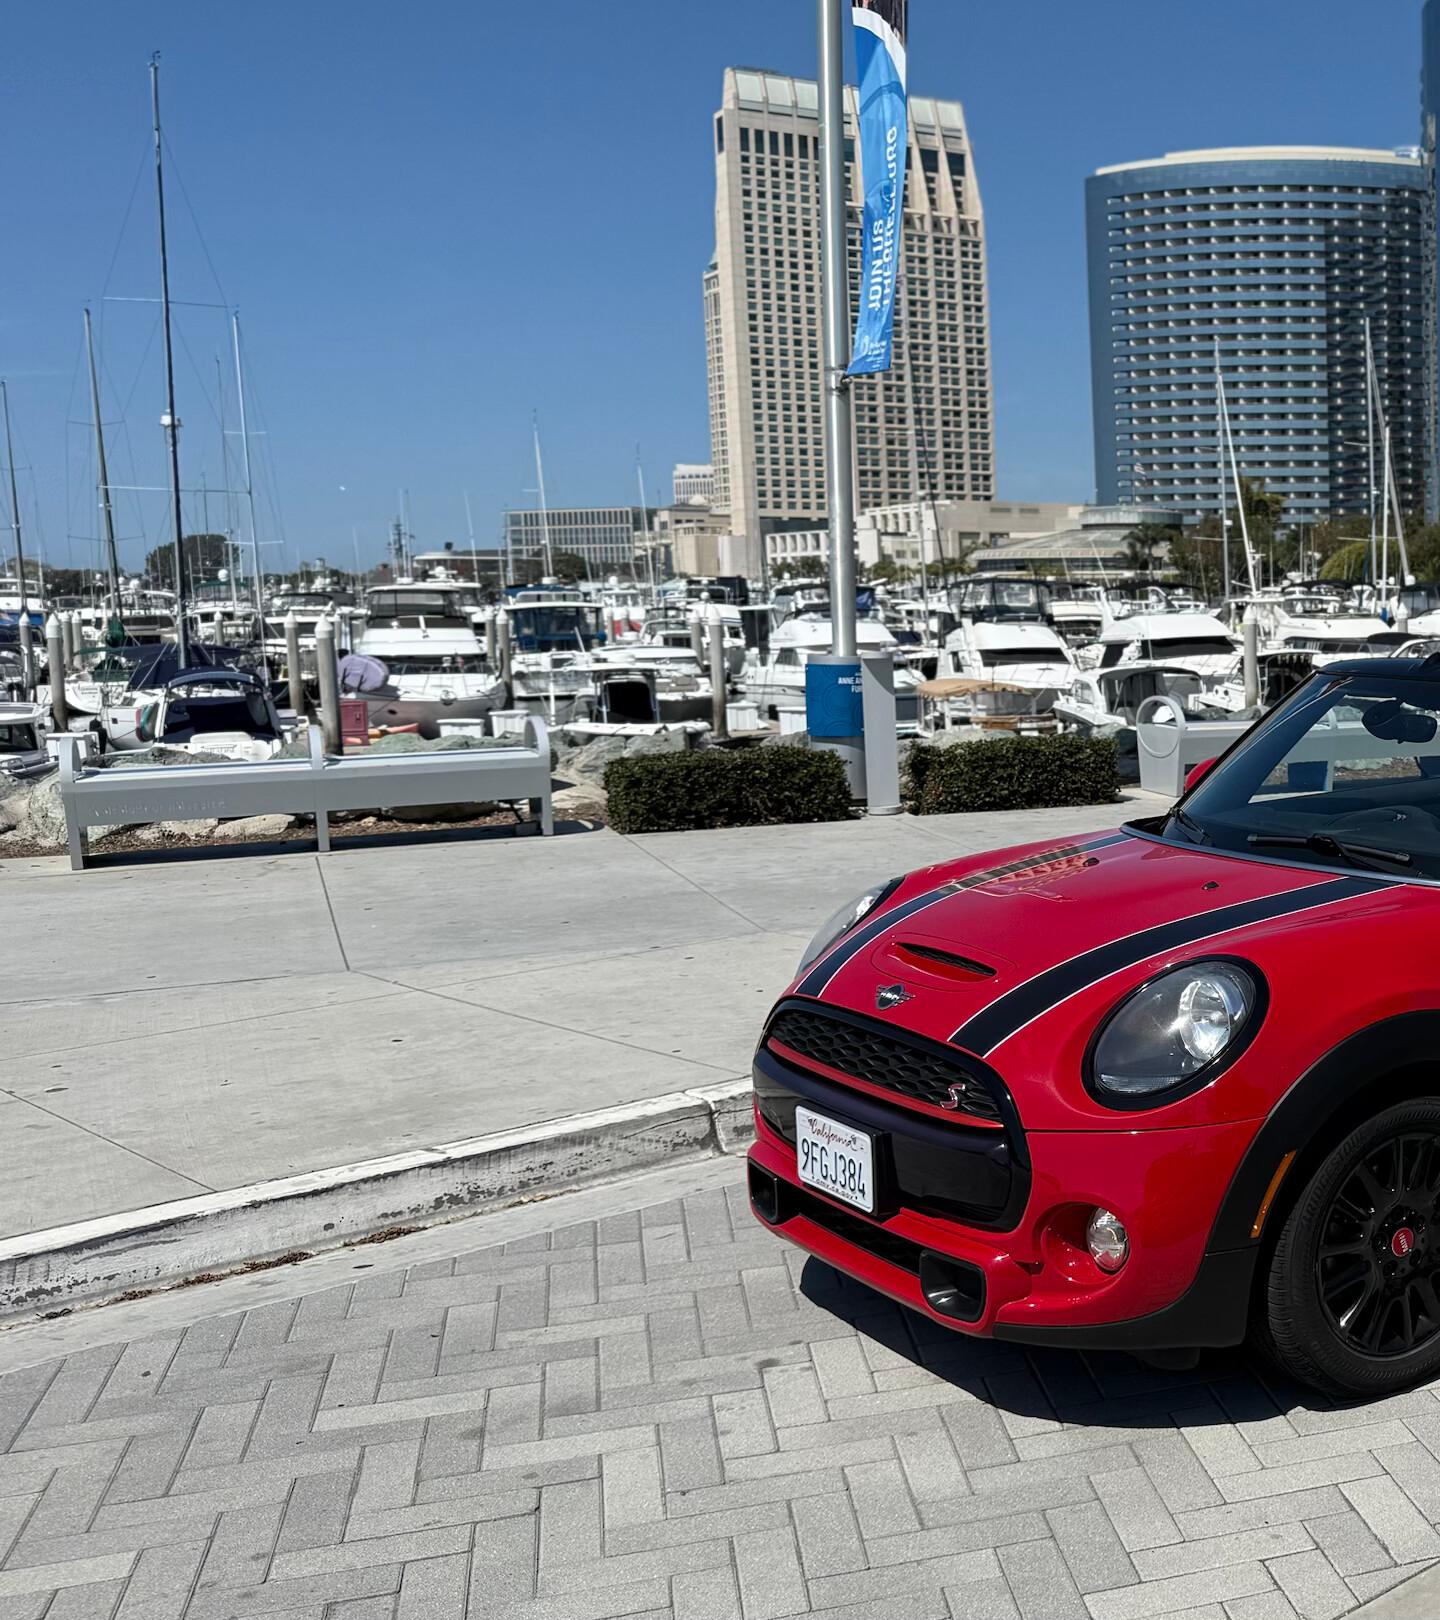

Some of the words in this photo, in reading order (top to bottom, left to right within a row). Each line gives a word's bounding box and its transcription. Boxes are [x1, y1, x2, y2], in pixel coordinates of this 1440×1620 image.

[871, 219, 884, 252] US
[867, 259, 883, 312] JOIN
[940, 1083, 966, 1109] S
[808, 1118, 857, 1152] California
[801, 1137, 866, 1200] 9FGJ384
